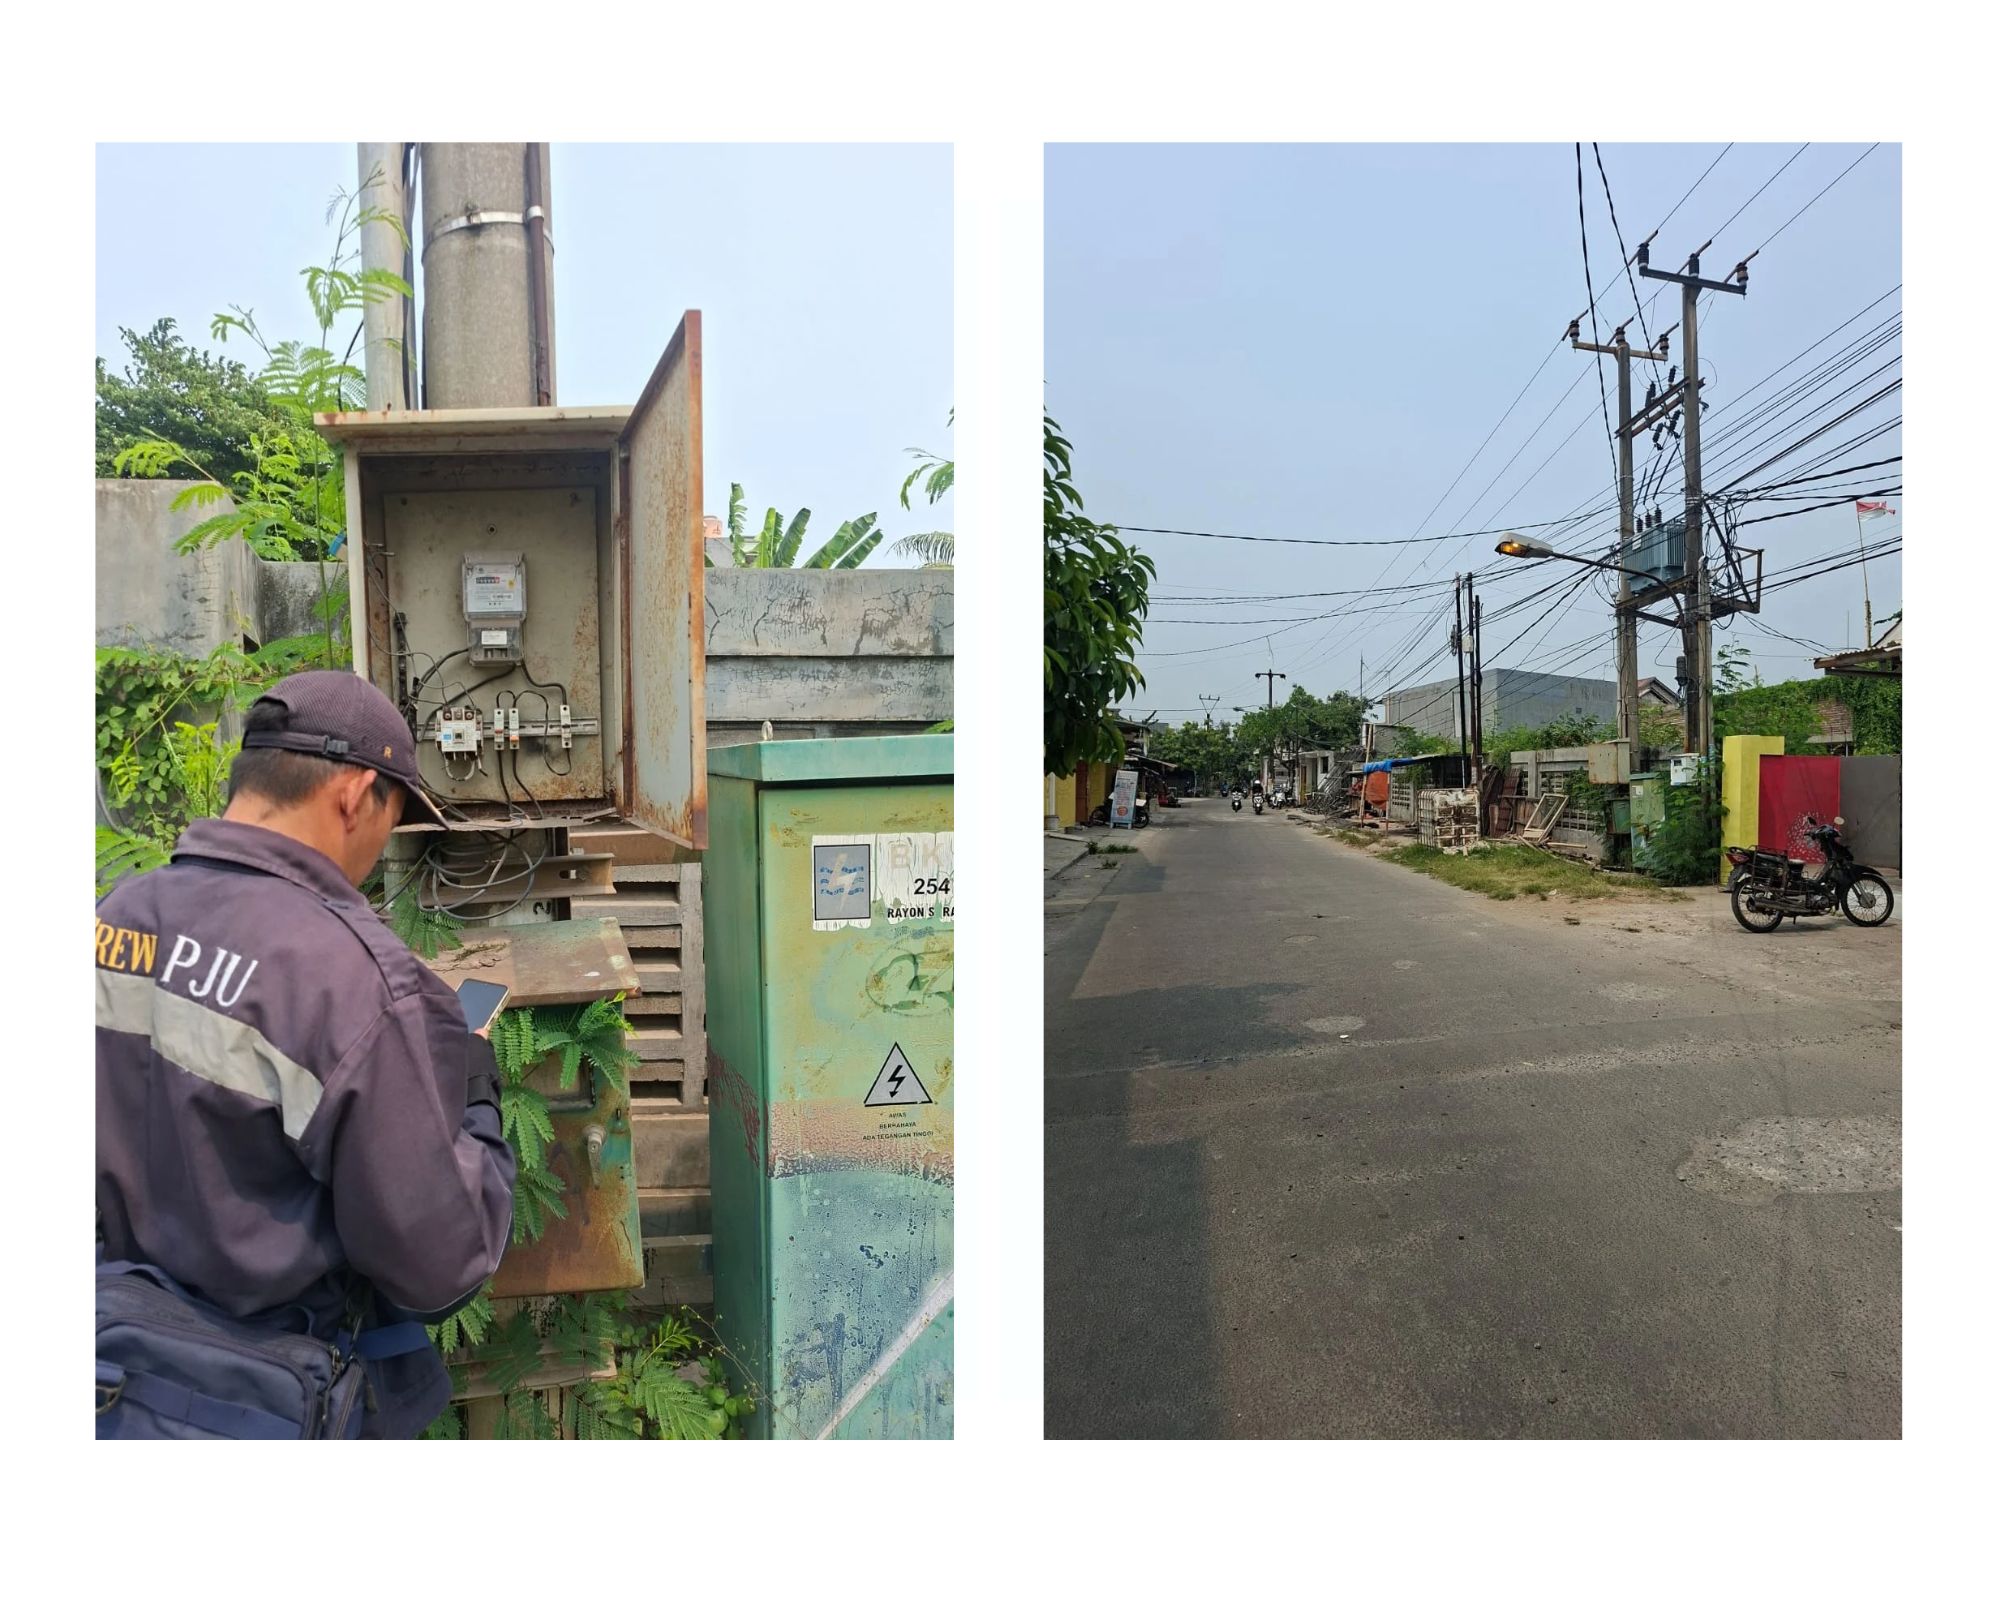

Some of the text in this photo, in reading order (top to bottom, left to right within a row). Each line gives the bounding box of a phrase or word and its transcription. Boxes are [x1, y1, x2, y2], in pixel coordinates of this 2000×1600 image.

[914, 877, 951, 895] 254
[887, 907, 925, 918] RAYON
[95, 918, 259, 1008] REW PJU
[877, 1132, 912, 1140] TEGANGAN
